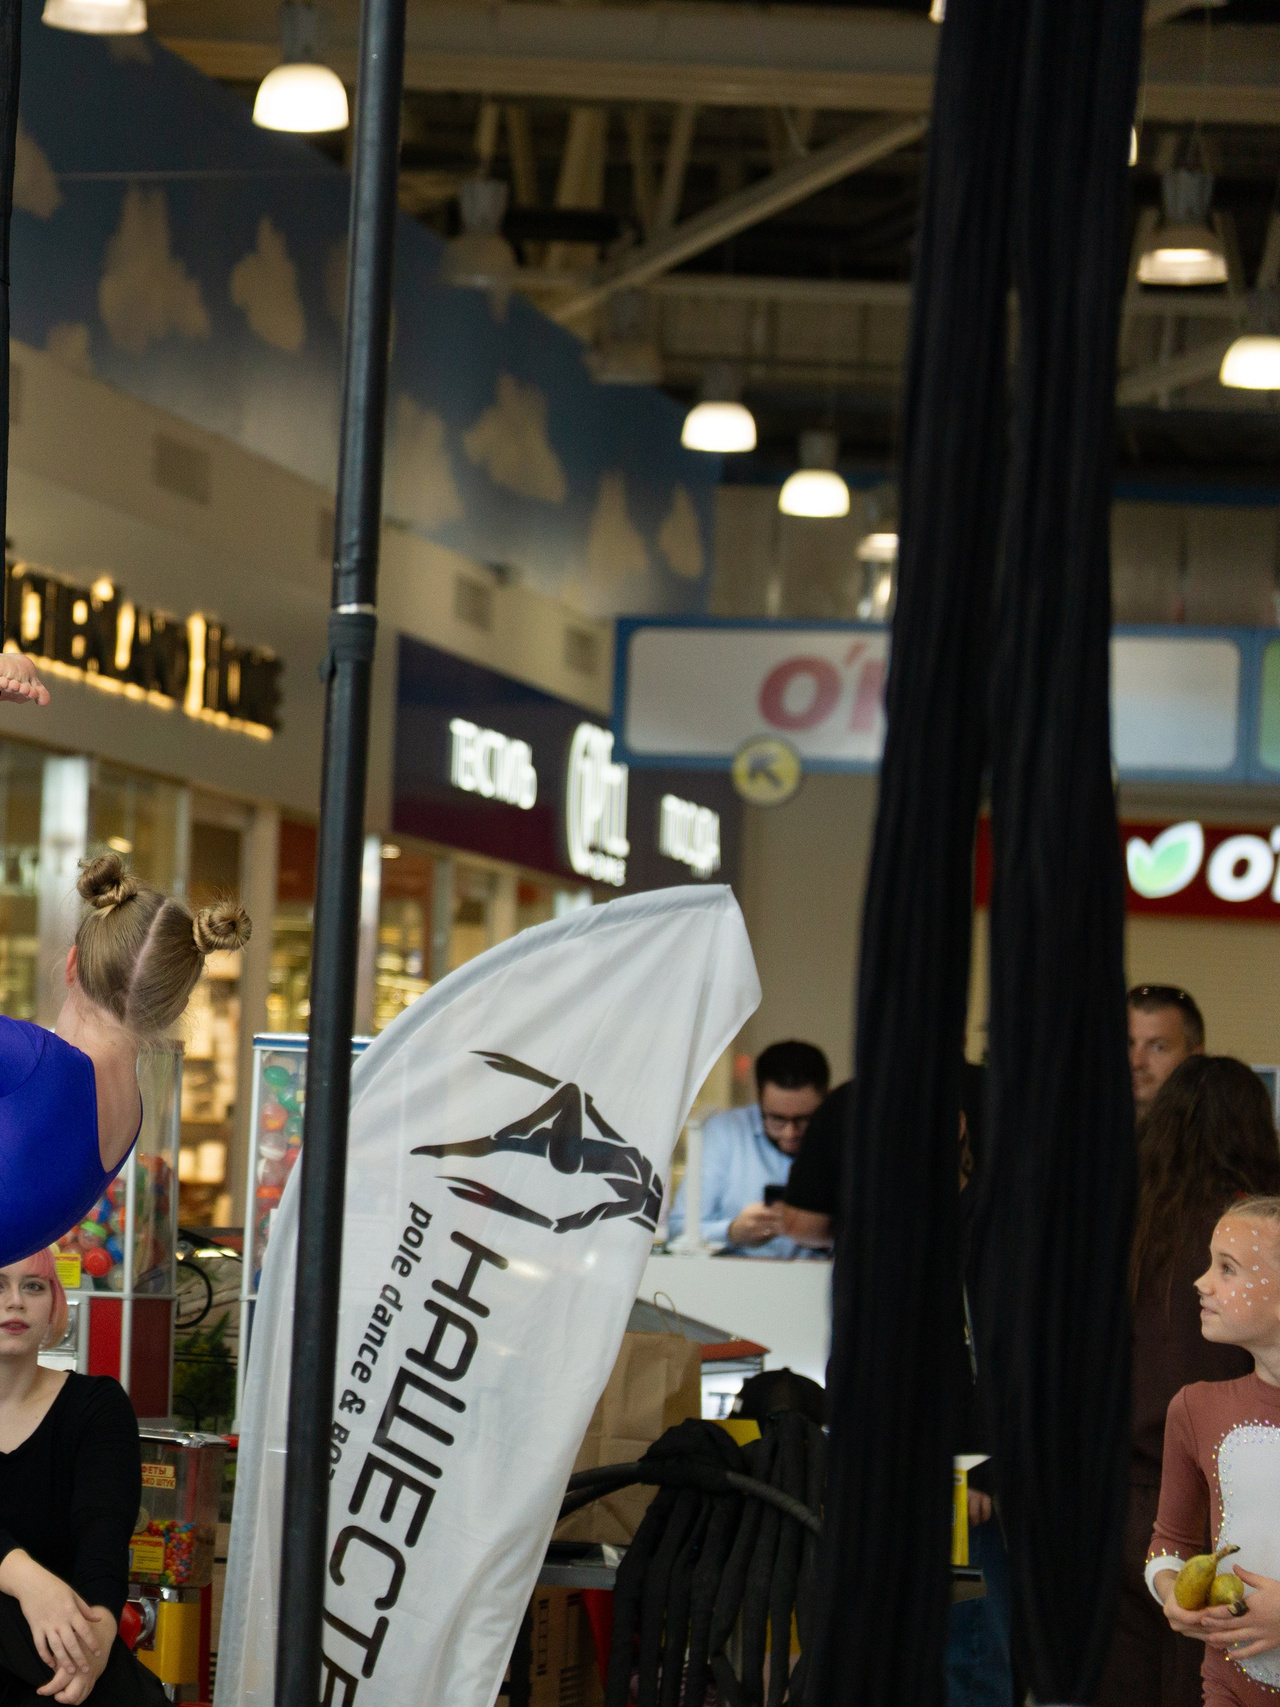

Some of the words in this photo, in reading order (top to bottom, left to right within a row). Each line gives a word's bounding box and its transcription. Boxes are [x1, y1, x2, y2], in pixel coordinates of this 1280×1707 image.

[391, 1201, 433, 1278] pole
[351, 1283, 404, 1384] dance
[142, 1466, 167, 1476] ФЕТЫ
